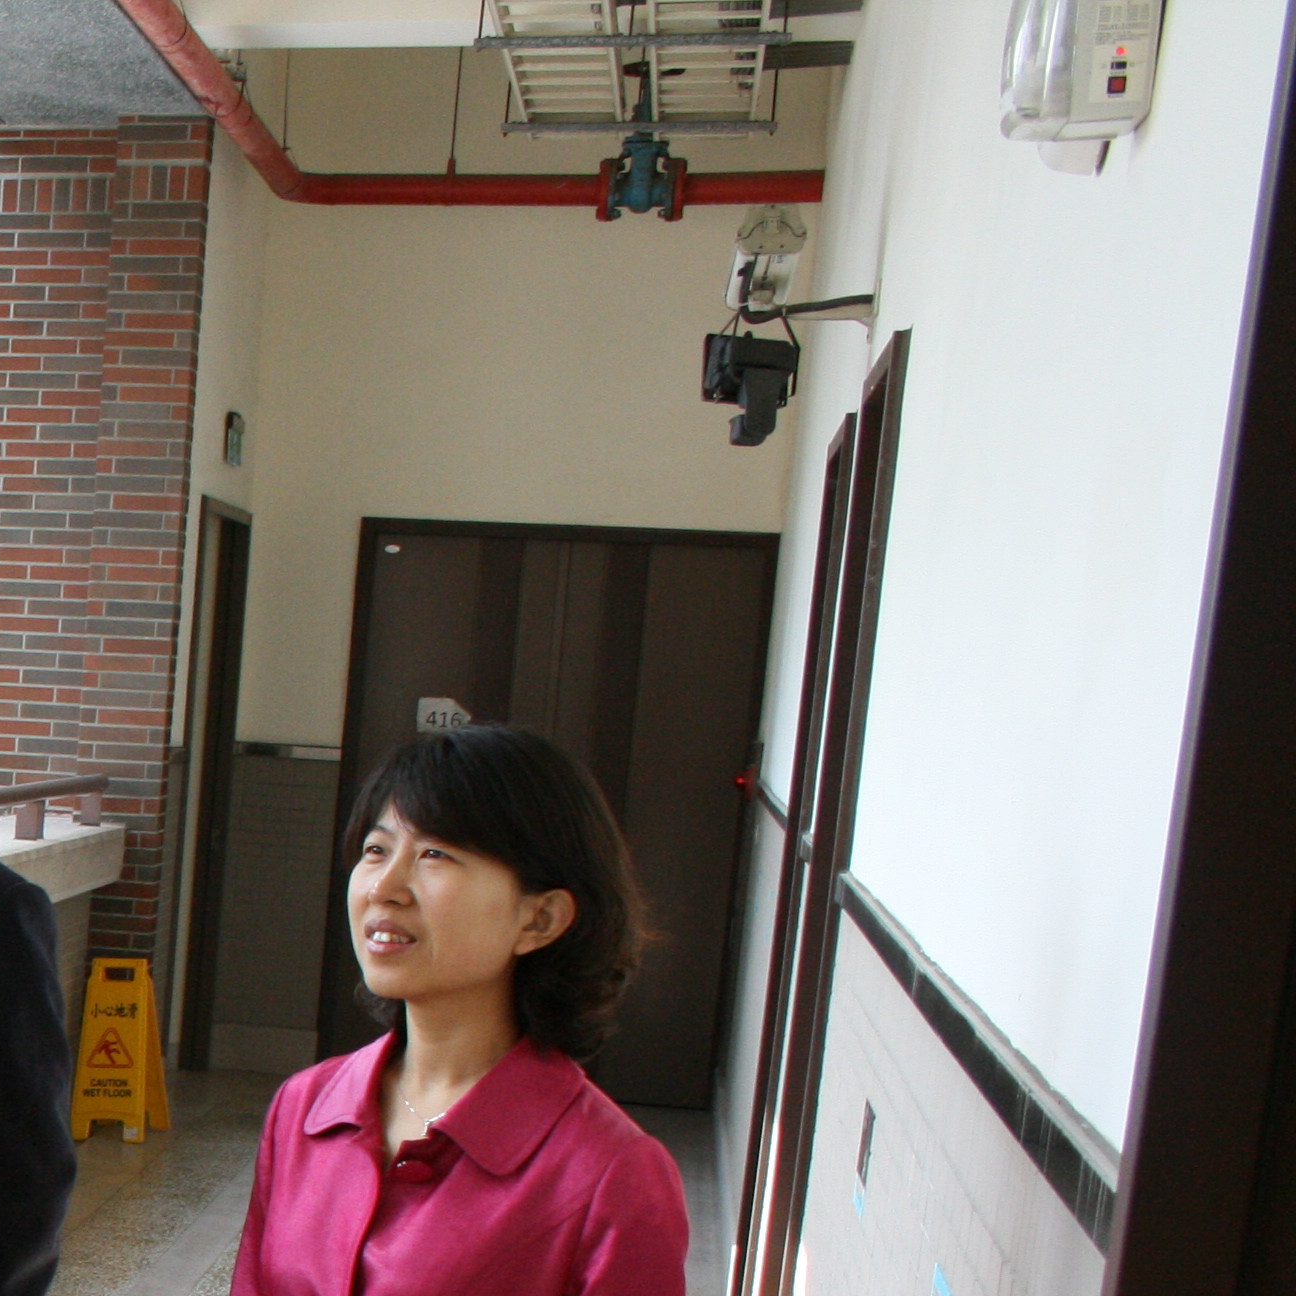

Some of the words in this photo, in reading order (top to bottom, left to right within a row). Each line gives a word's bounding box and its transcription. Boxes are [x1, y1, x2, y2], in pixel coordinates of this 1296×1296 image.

[426, 711, 462, 728] 416
[90, 1003, 138, 1019] 小心地滑
[90, 1079, 128, 1087] CAUTION
[83, 1088, 101, 1097] WET
[103, 1088, 132, 1097] FLOOR
